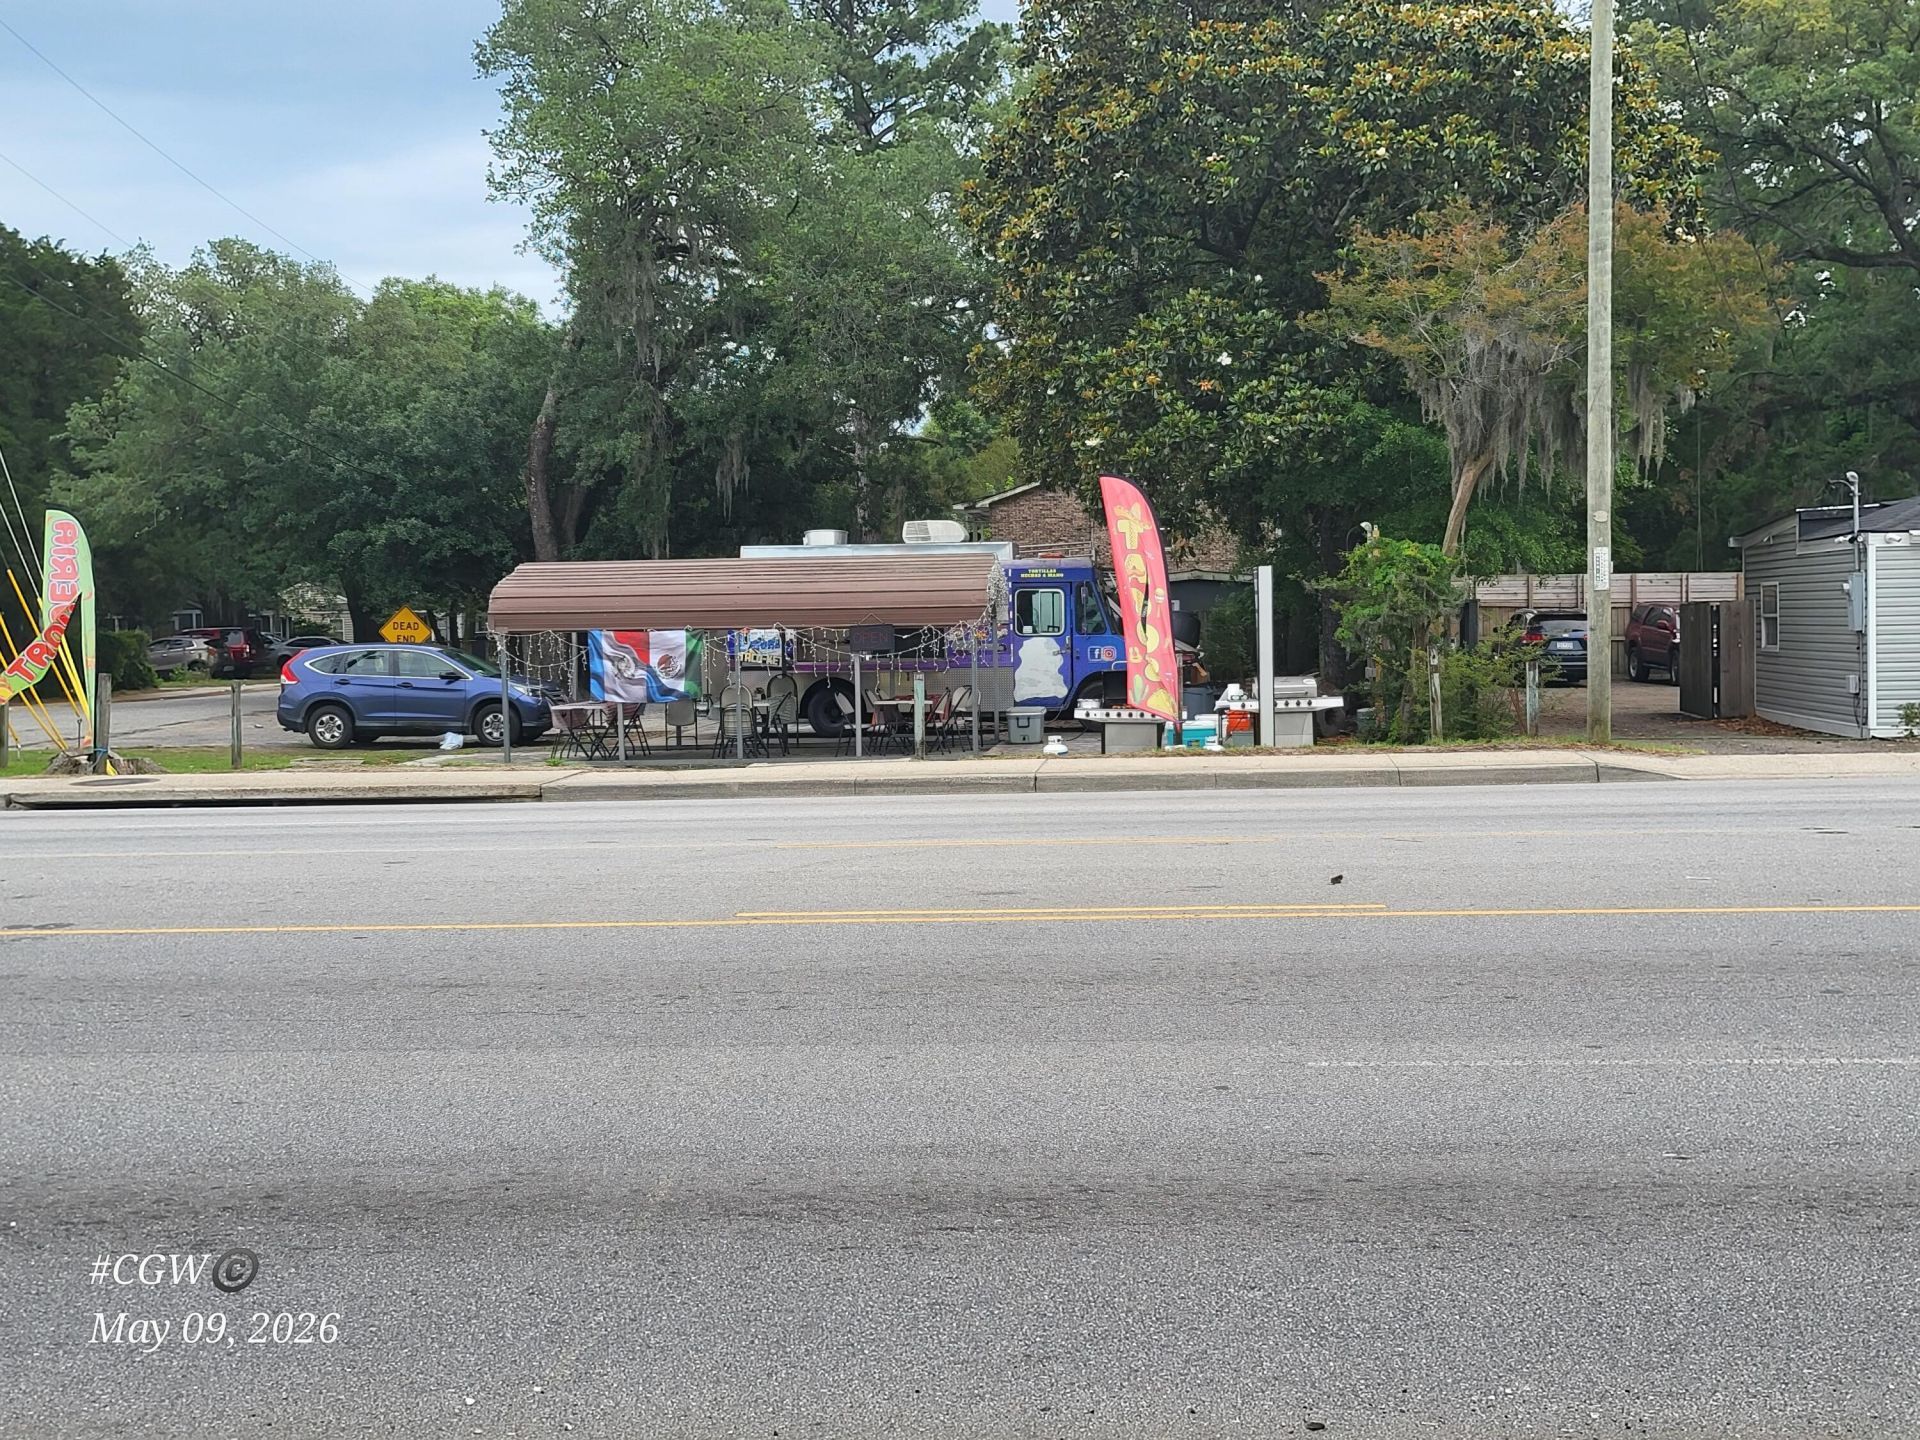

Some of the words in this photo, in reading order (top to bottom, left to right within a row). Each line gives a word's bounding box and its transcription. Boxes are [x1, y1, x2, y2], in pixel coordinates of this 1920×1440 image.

[393, 621, 419, 631] DEAD
[397, 635, 415, 643] END
[853, 631, 889, 644] OPEN
